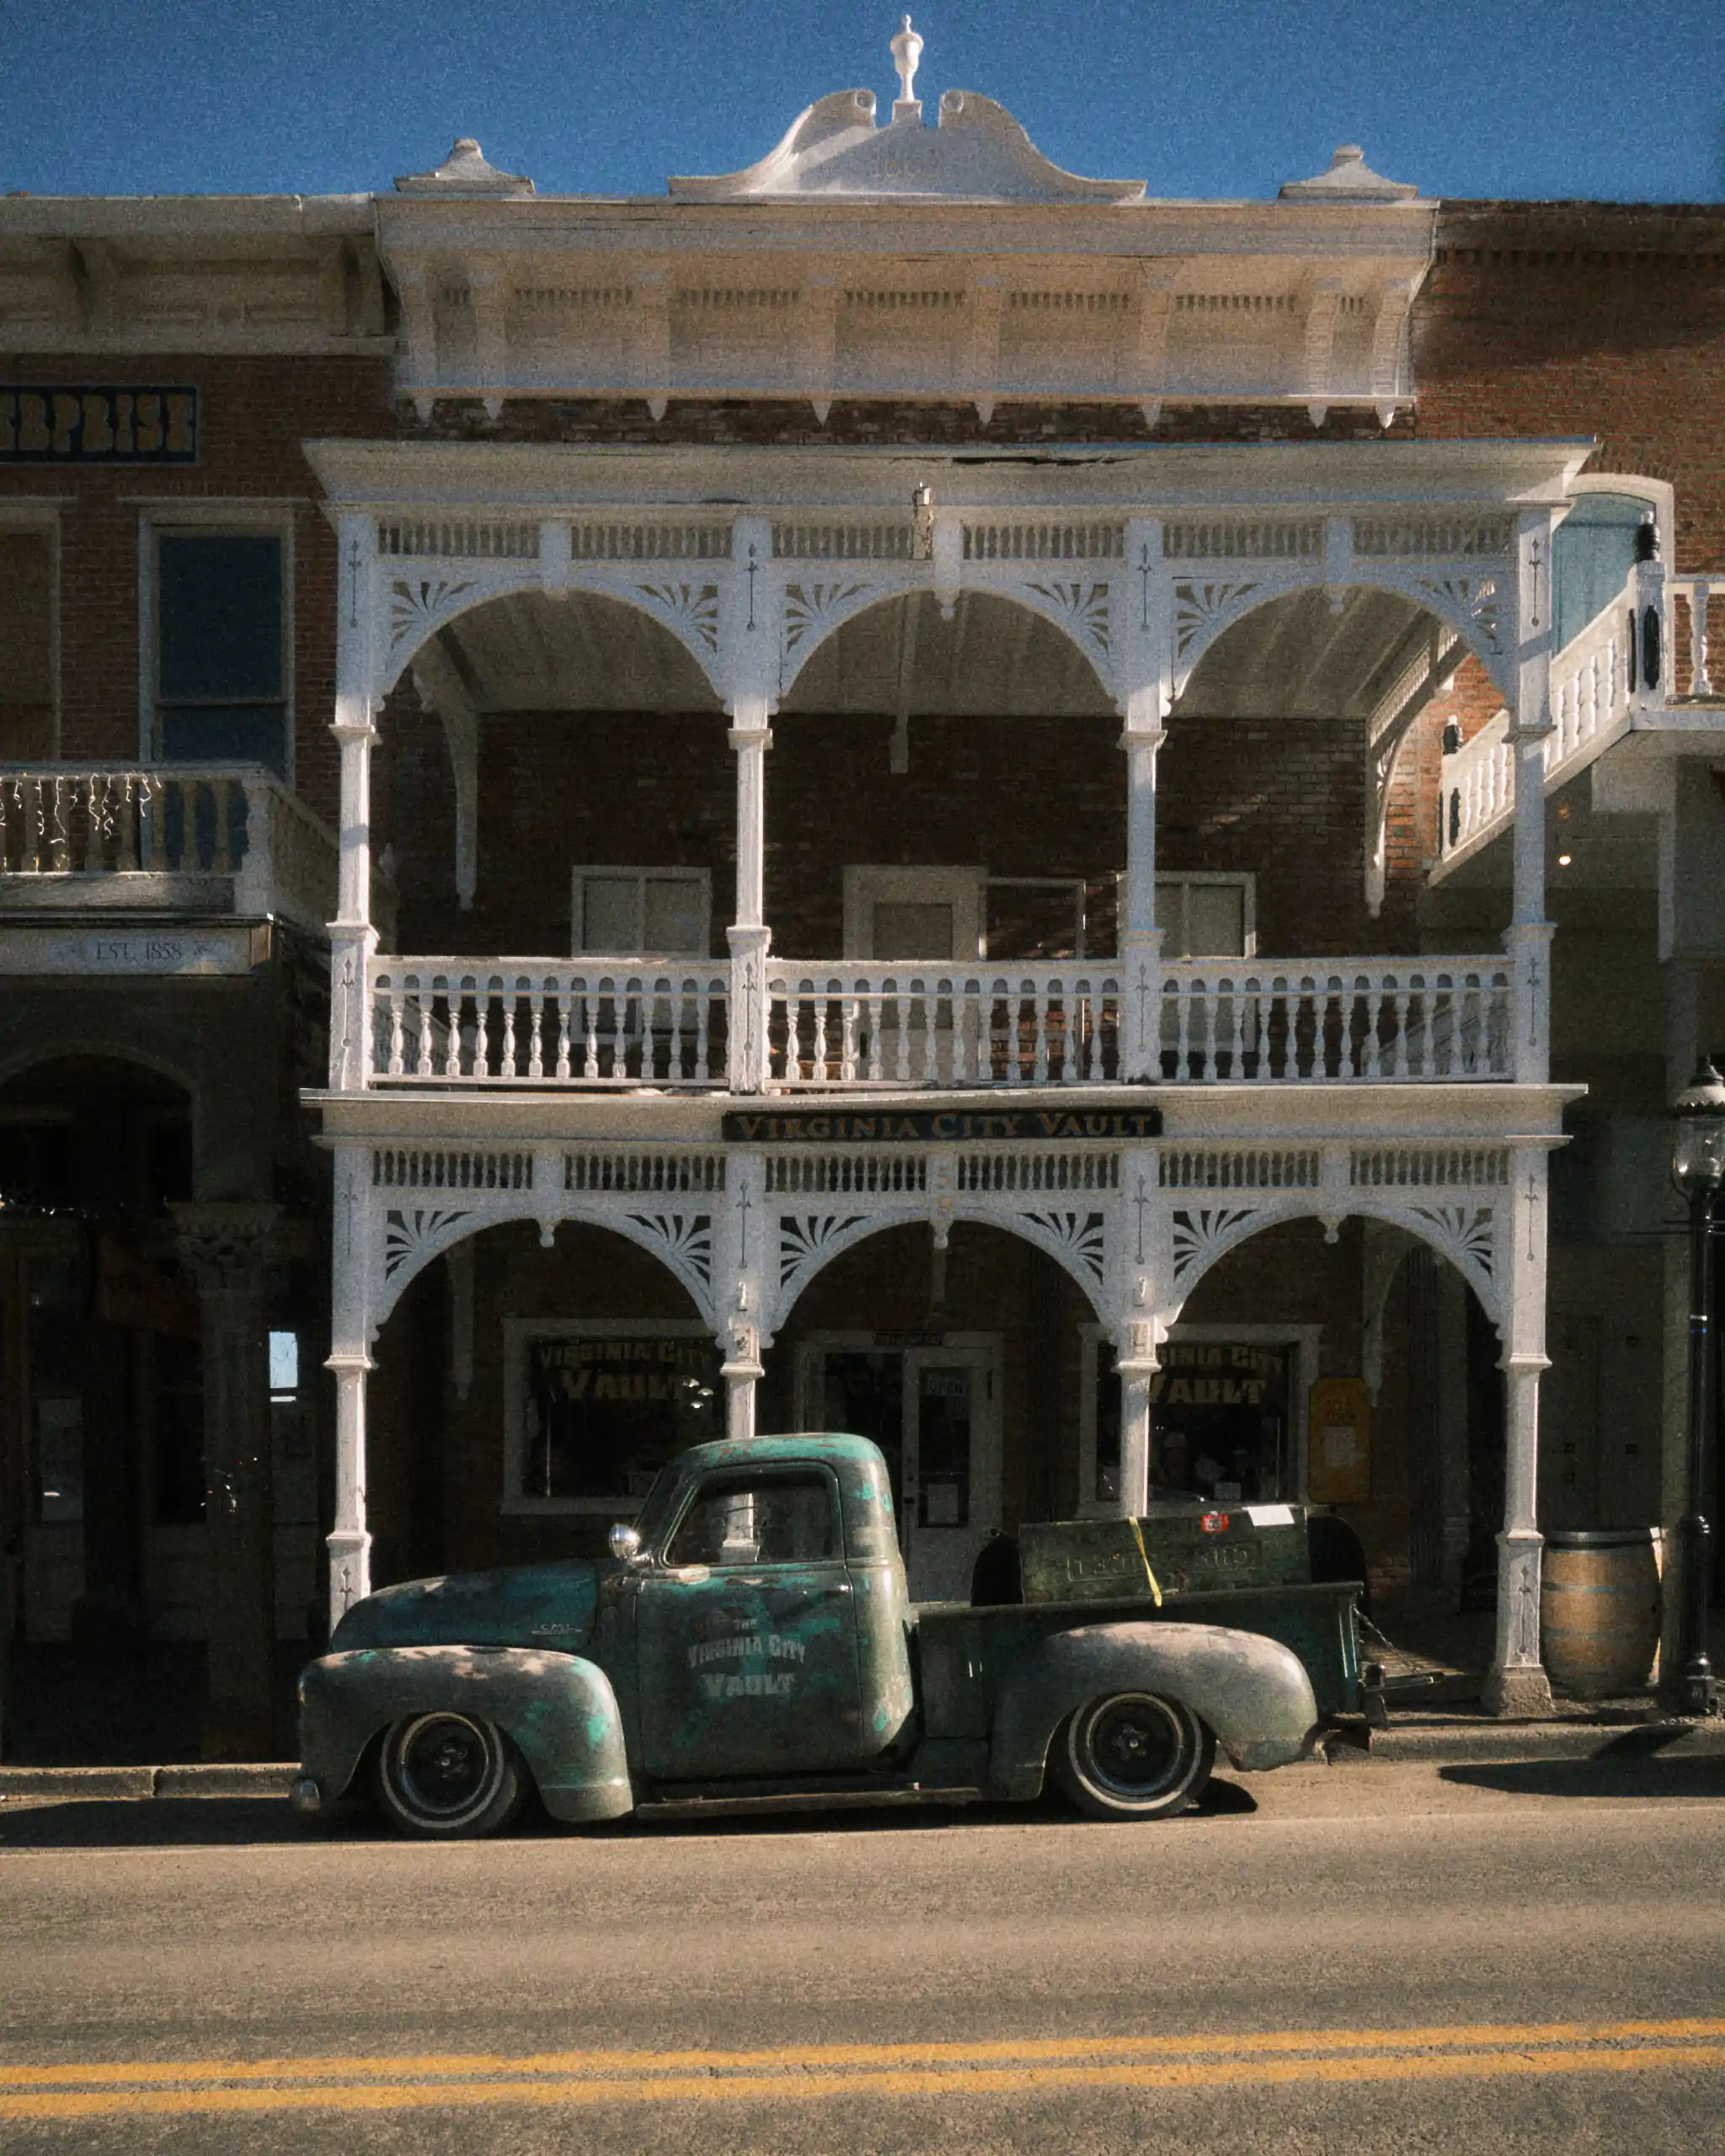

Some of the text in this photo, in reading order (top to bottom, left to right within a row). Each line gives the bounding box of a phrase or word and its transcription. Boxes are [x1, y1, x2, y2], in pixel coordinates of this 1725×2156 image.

[146, 942, 182, 960] 1858
[735, 1113, 1152, 1139] VIRGINIA CITY VAULT
[560, 1369, 689, 1403] VAULT
[687, 1634, 806, 1668] VIRGINIA CITY
[700, 1673, 797, 1697] VAULT
